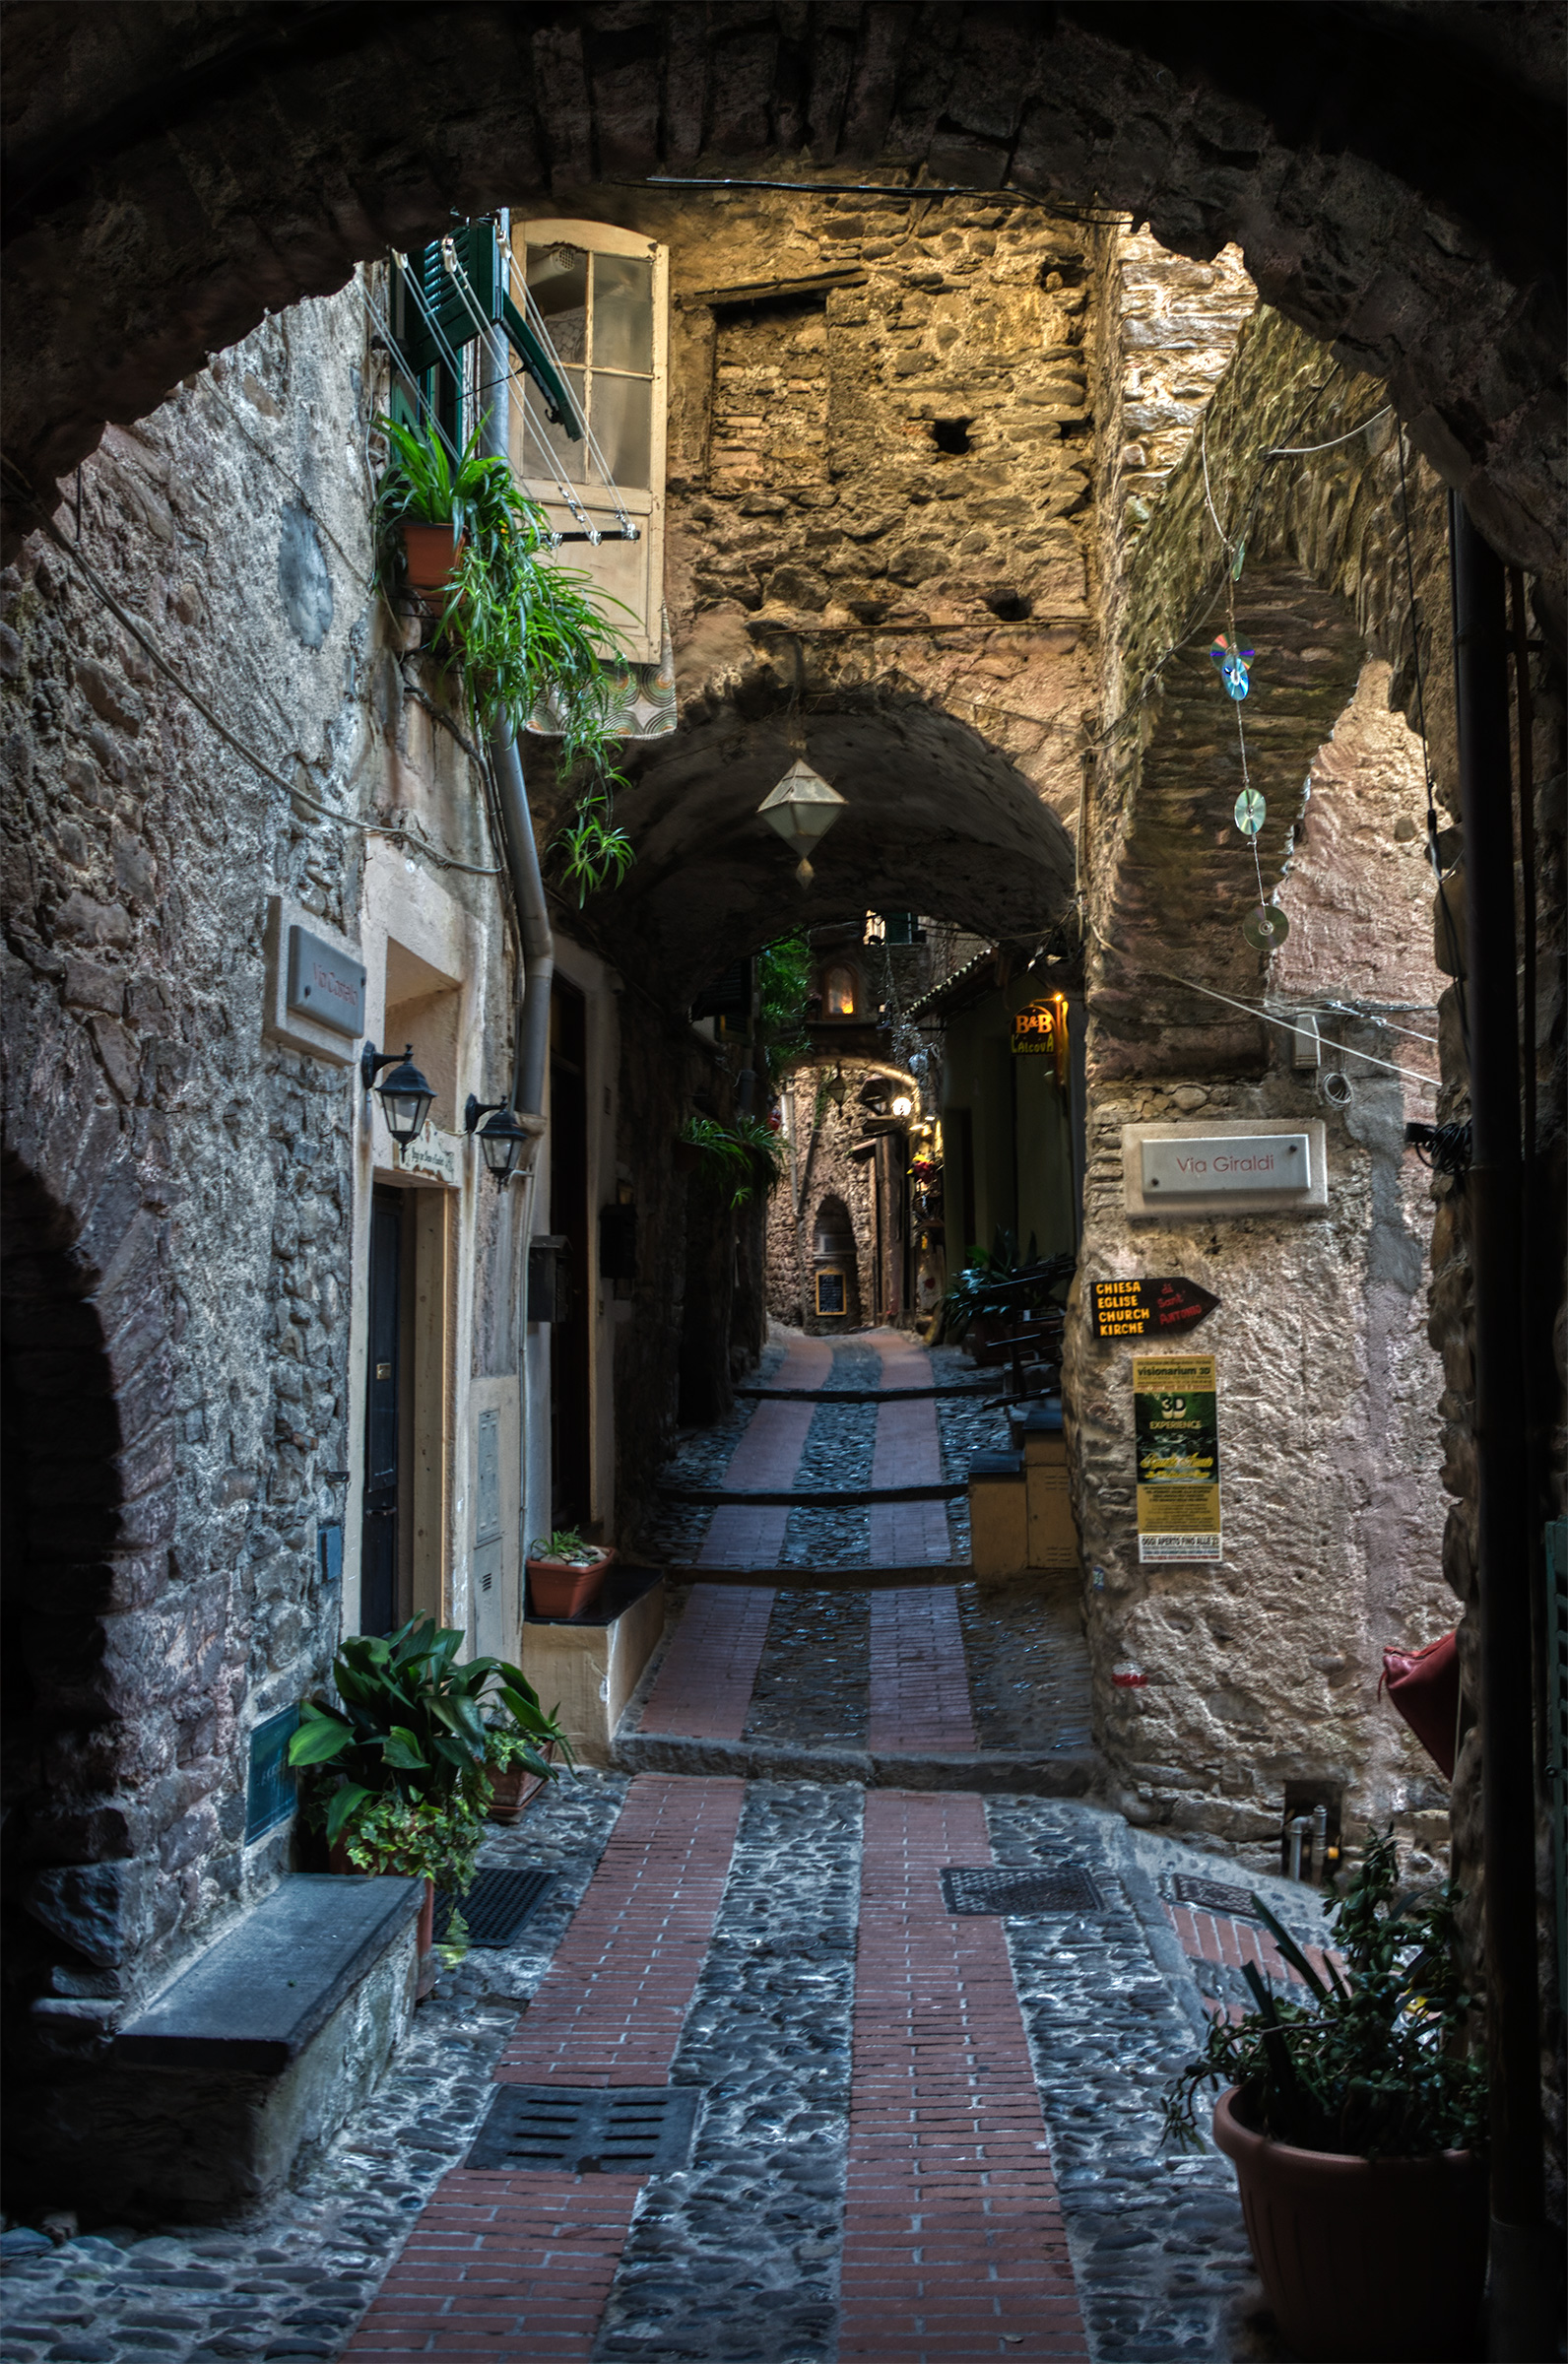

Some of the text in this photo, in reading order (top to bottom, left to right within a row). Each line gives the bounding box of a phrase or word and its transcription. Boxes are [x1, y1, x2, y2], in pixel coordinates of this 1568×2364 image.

[313, 962, 326, 988] Via
[1015, 1014, 1053, 1034] B&B
[1176, 1154, 1274, 1173] Via Giraldi
[1095, 1280, 1142, 1295] CHIESA
[1096, 1294, 1139, 1309] EGLISE
[1098, 1307, 1150, 1323] CHURCH
[1099, 1321, 1145, 1337] KIRCHE
[1138, 1366, 1197, 1376] visionarium
[1161, 1396, 1187, 1419] 3D
[1149, 1419, 1204, 1430] EXPERIENCE
